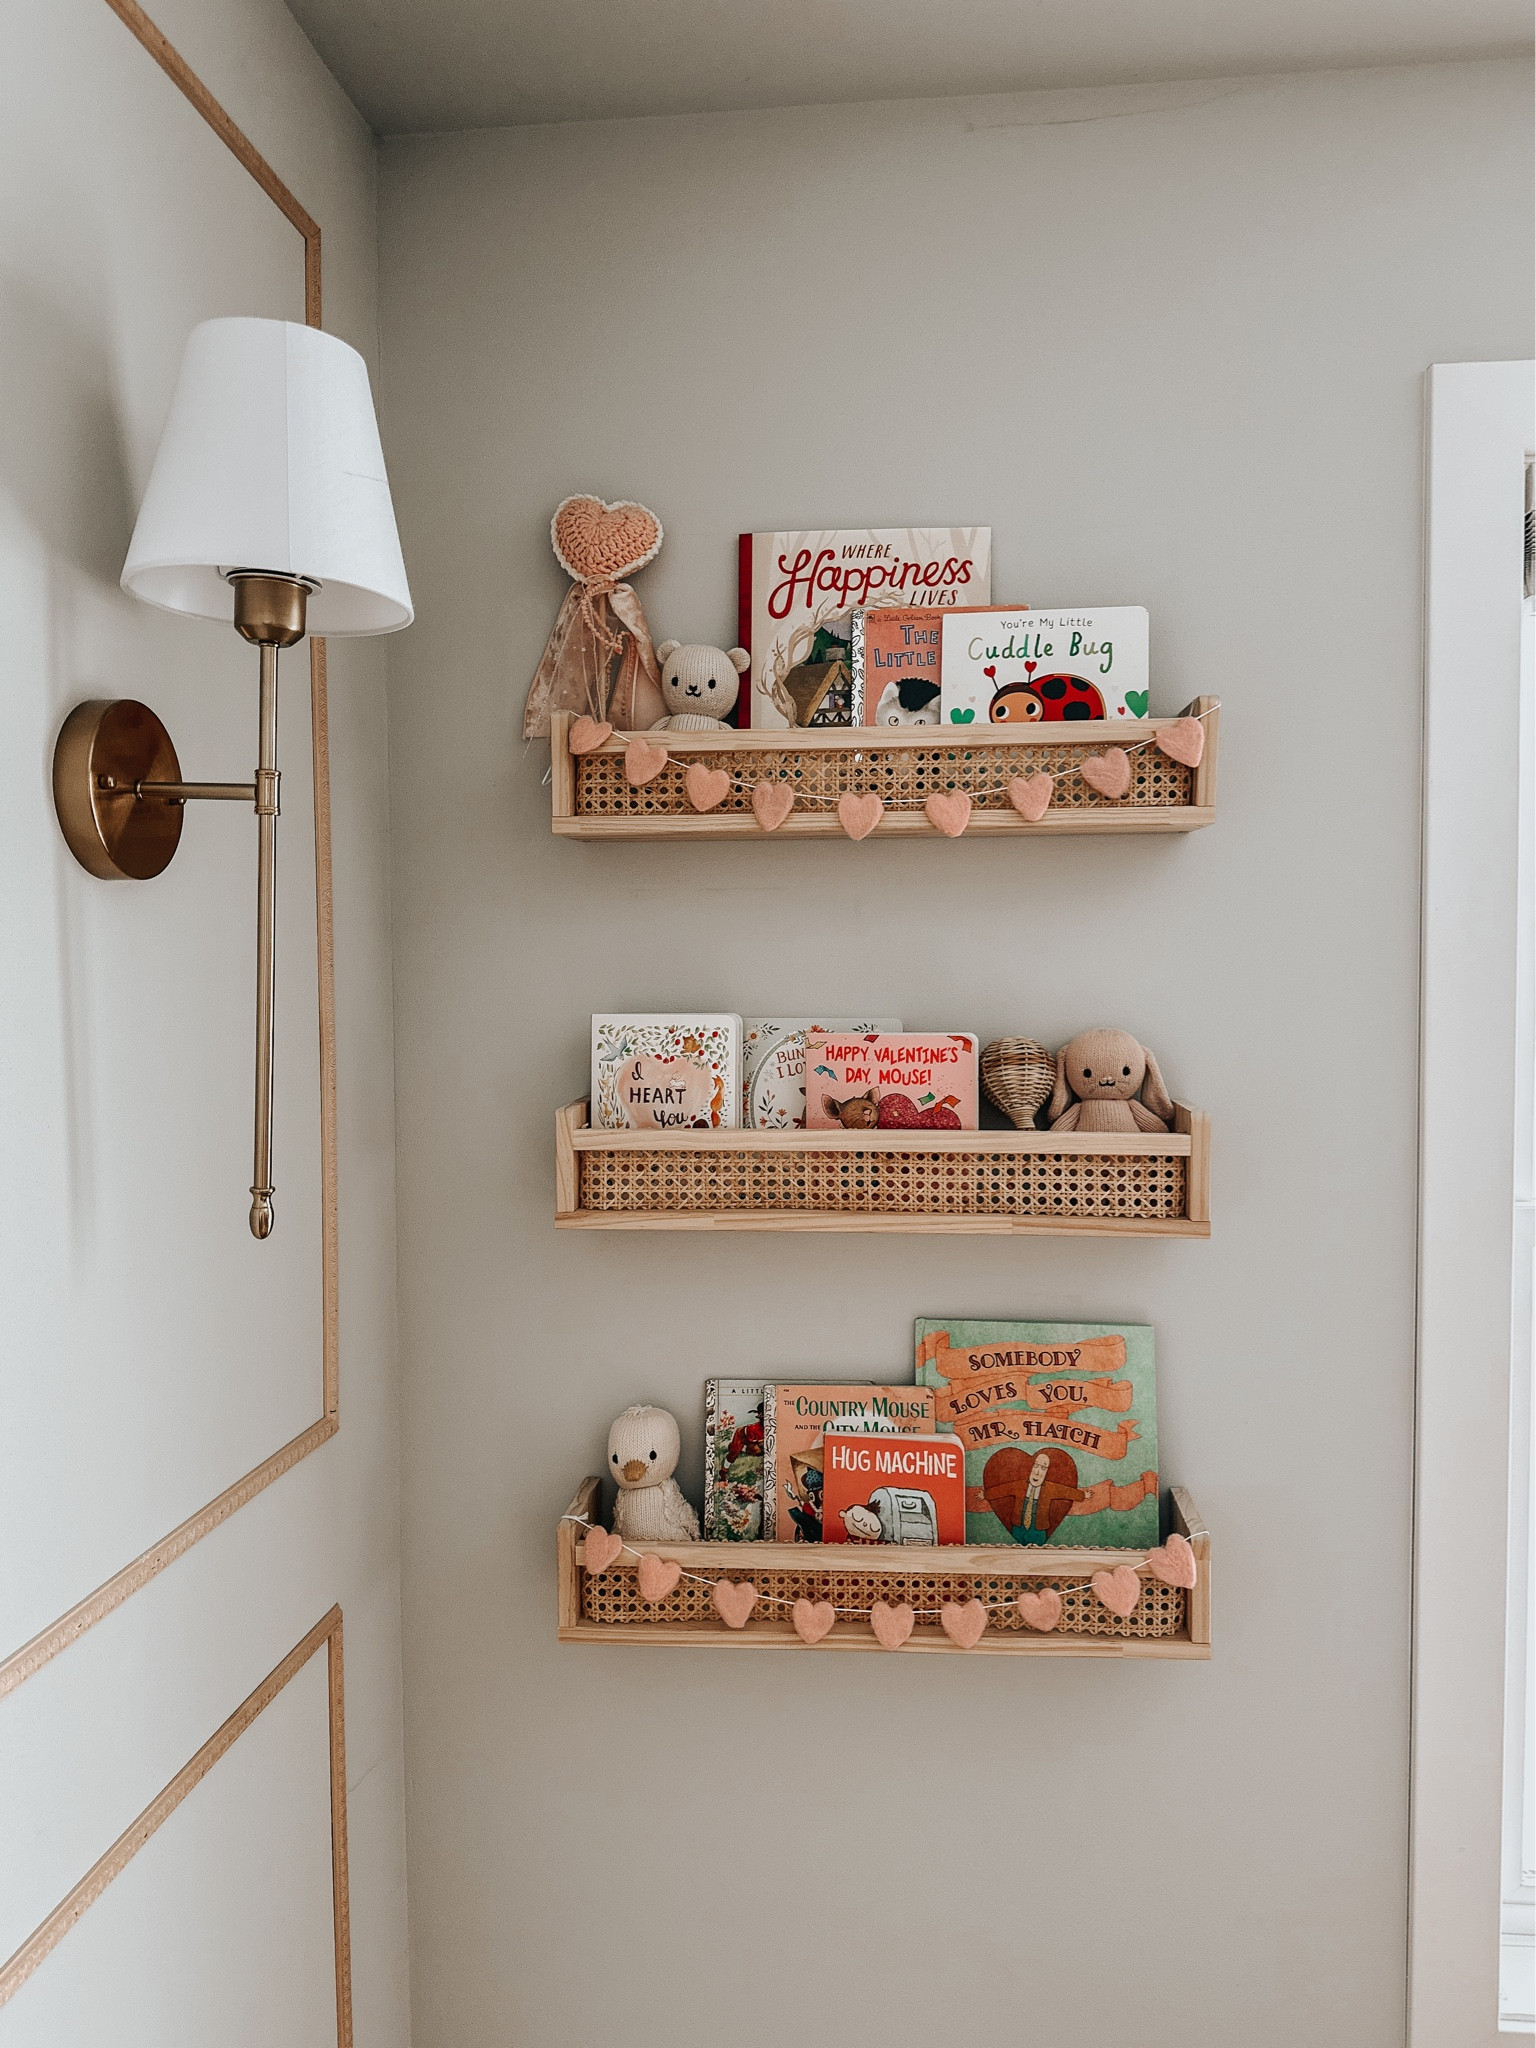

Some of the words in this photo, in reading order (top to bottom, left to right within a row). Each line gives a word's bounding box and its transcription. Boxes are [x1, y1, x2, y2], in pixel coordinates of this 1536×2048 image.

[842, 544, 893, 559] WHERE
[768, 549, 973, 619] Happiness
[909, 590, 958, 606] LIVES
[1000, 618, 1034, 629] You're
[1039, 618, 1054, 629] My
[1059, 617, 1093, 627] Little
[900, 624, 939, 645] THE
[874, 648, 936, 667] LITTLE
[968, 633, 1054, 661] Cuddle
[1069, 631, 1113, 674] Bug
[826, 1045, 869, 1062] HAPPY
[874, 1046, 959, 1065] VALENTINE'S
[776, 1066, 784, 1078] I
[787, 1061, 806, 1077] LO
[845, 1067, 871, 1085] DAY,
[879, 1068, 932, 1086] MOUSE!
[629, 1087, 687, 1105] HEART
[968, 1349, 1081, 1371] SOMEBODY
[796, 1396, 868, 1417] COUNTRY
[872, 1397, 930, 1419] MOUSE
[949, 1382, 1018, 1414] LOVES
[1038, 1383, 1088, 1403] YOU,
[968, 1421, 1020, 1441] MR.
[1023, 1420, 1101, 1449] HATCH
[832, 1445, 870, 1472] HUG
[875, 1450, 957, 1478] MACHINE
